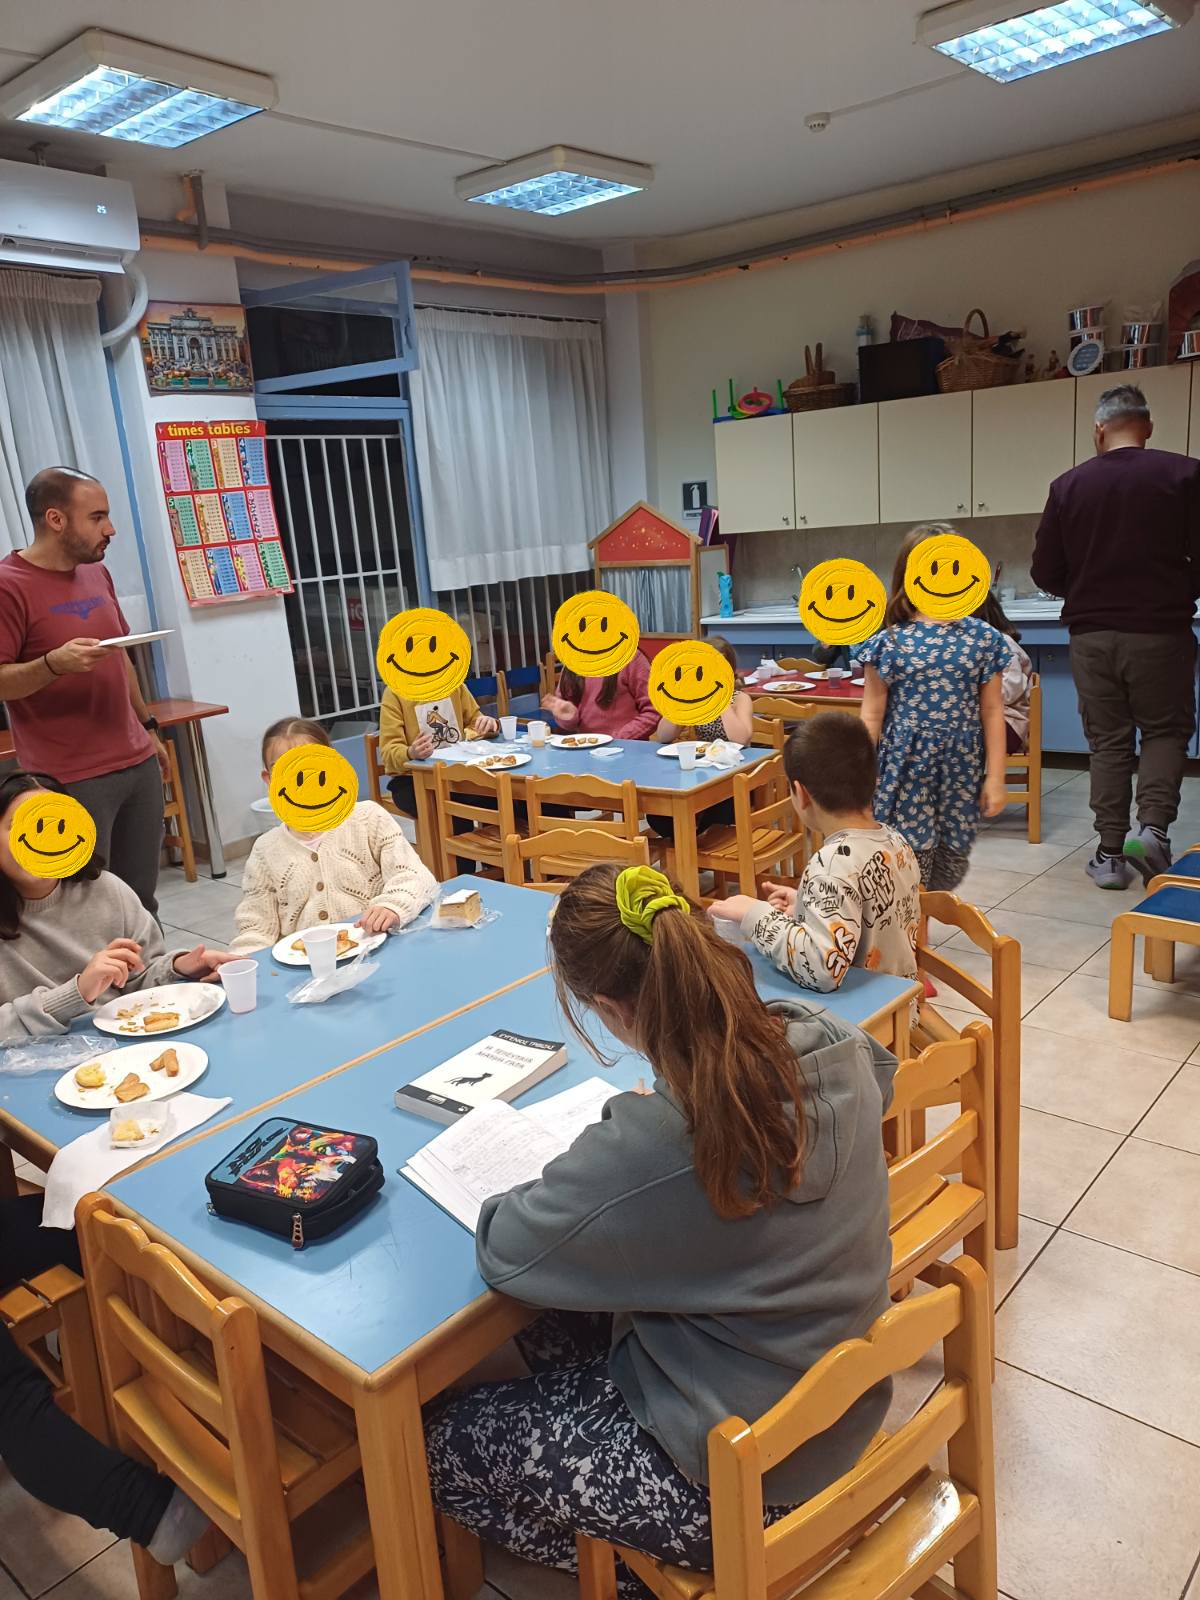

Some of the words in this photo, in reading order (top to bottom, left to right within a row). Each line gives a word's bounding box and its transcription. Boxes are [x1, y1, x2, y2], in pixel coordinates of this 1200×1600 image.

[167, 424, 205, 437] times
[208, 422, 251, 435] tables
[818, 881, 839, 895] OWN
